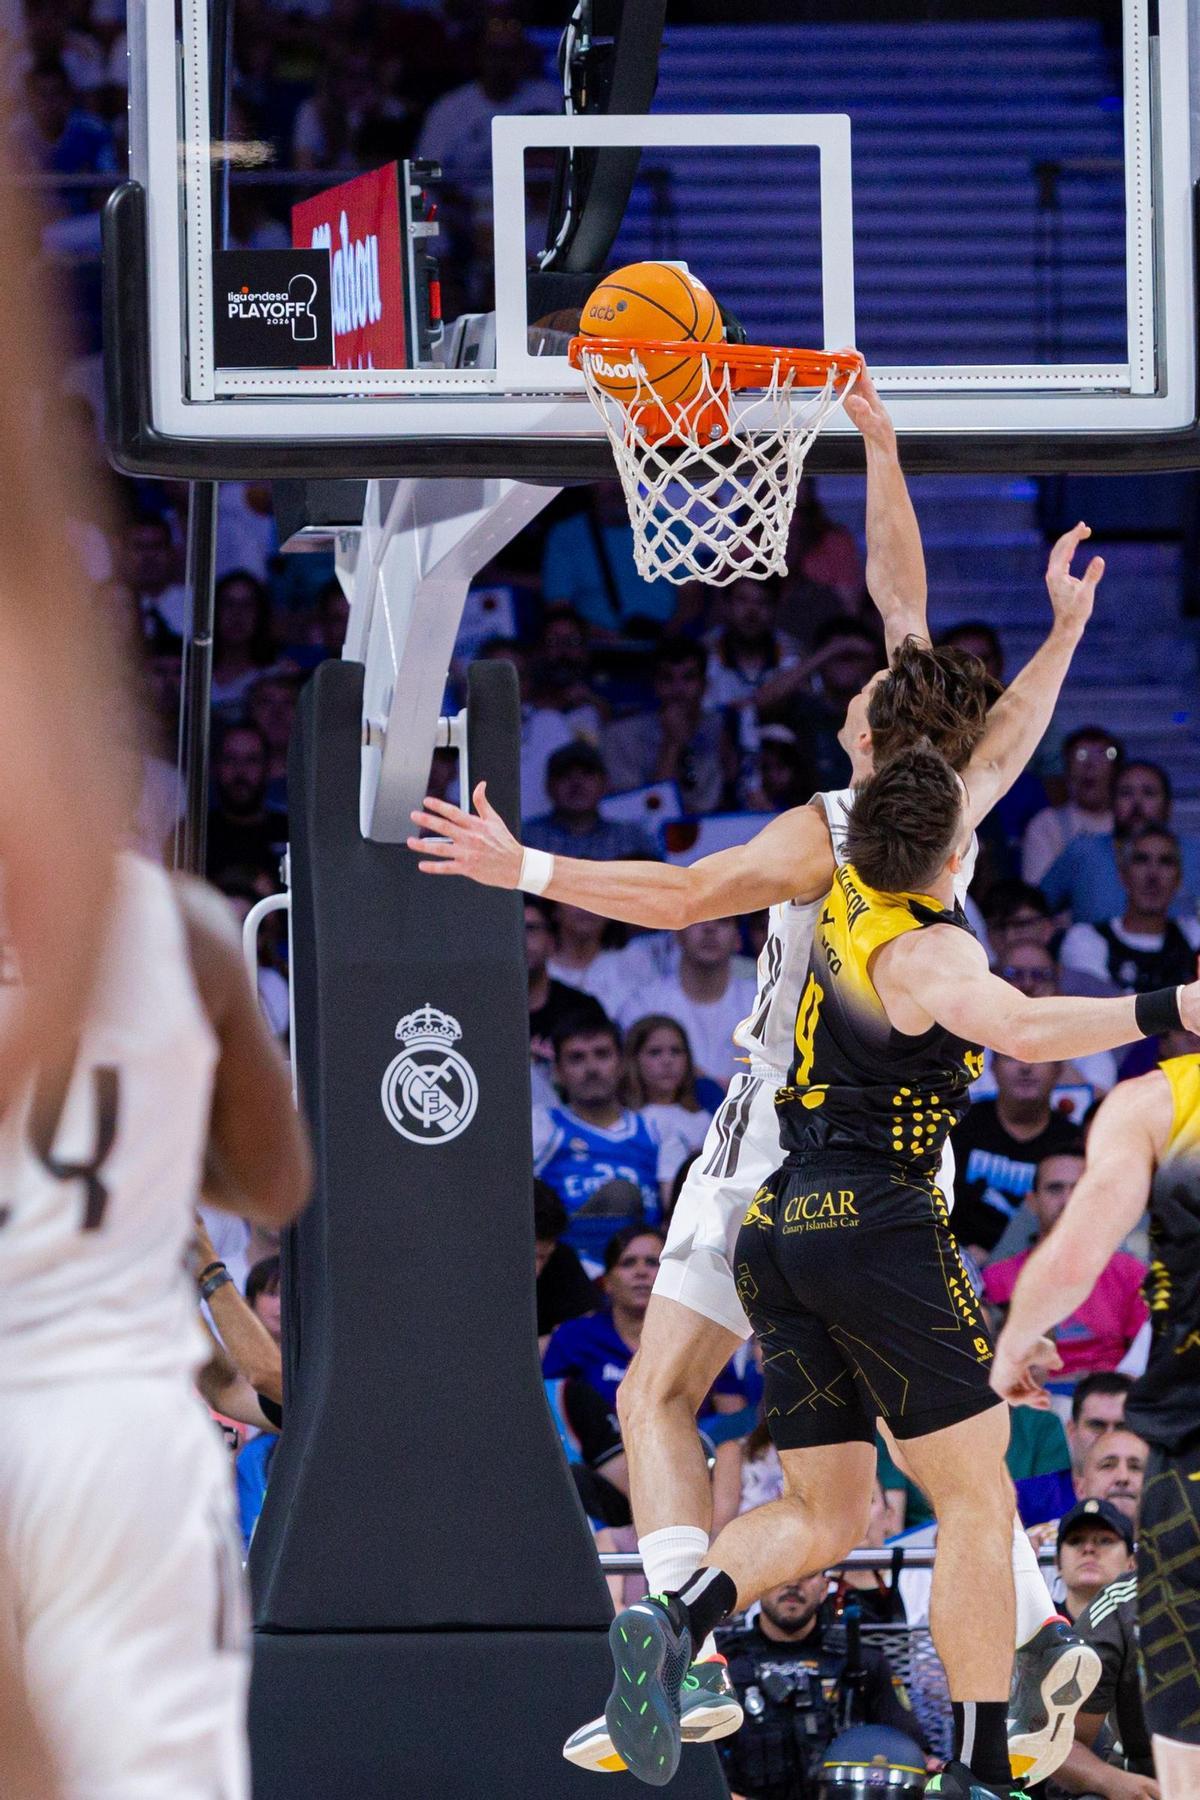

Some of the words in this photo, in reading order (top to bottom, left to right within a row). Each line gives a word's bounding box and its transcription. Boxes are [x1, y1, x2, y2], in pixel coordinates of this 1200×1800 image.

[311, 209, 382, 335] ahou
[228, 302, 306, 318] PLAYOFF
[589, 304, 615, 321] acb
[589, 353, 648, 377] ilson
[784, 1190, 859, 1223] CICAR
[782, 1224, 805, 1235] Canary
[805, 1218, 838, 1231] Islands
[840, 1217, 860, 1228] Car
